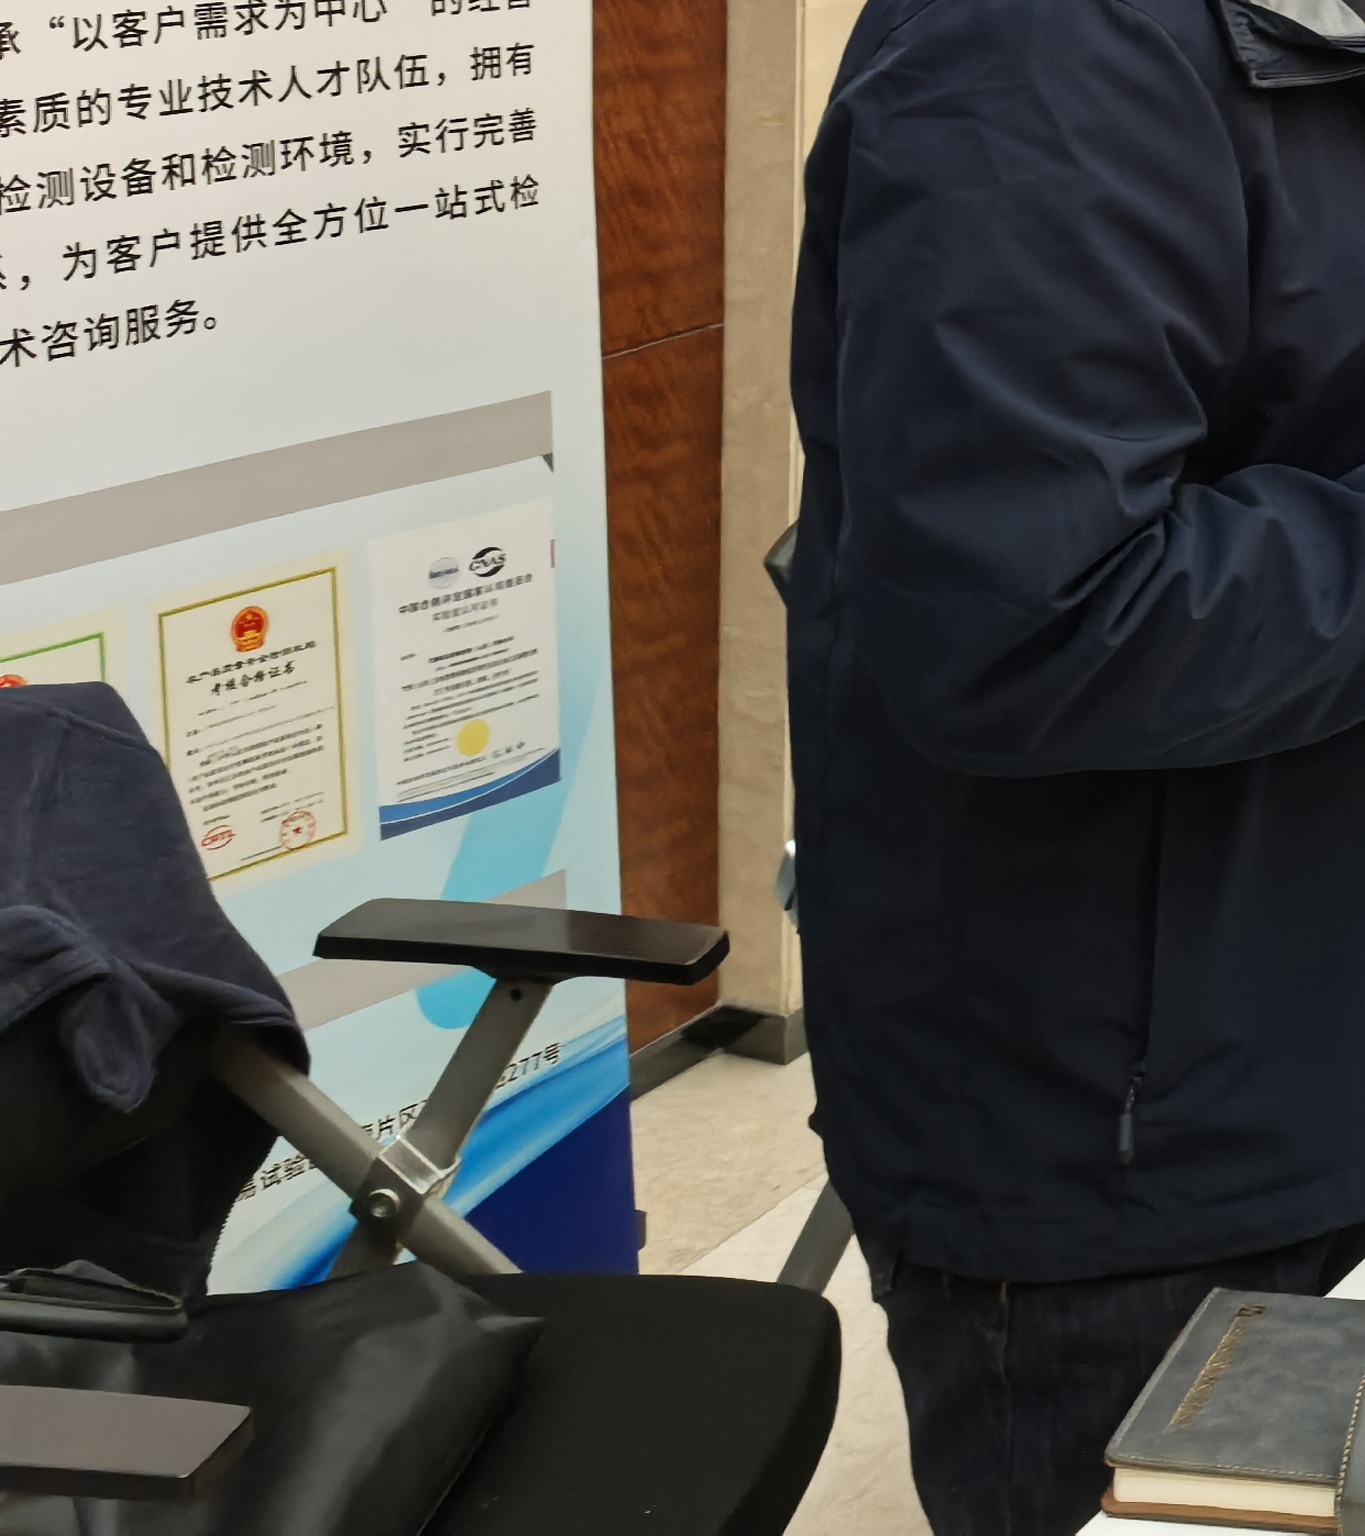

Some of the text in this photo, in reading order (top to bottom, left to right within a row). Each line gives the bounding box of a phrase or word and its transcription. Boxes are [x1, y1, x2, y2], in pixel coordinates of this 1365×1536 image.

[0, 174, 540, 292] ，为客户提供全方位一站式检
[0, 298, 218, 367] 术咨询服务。
